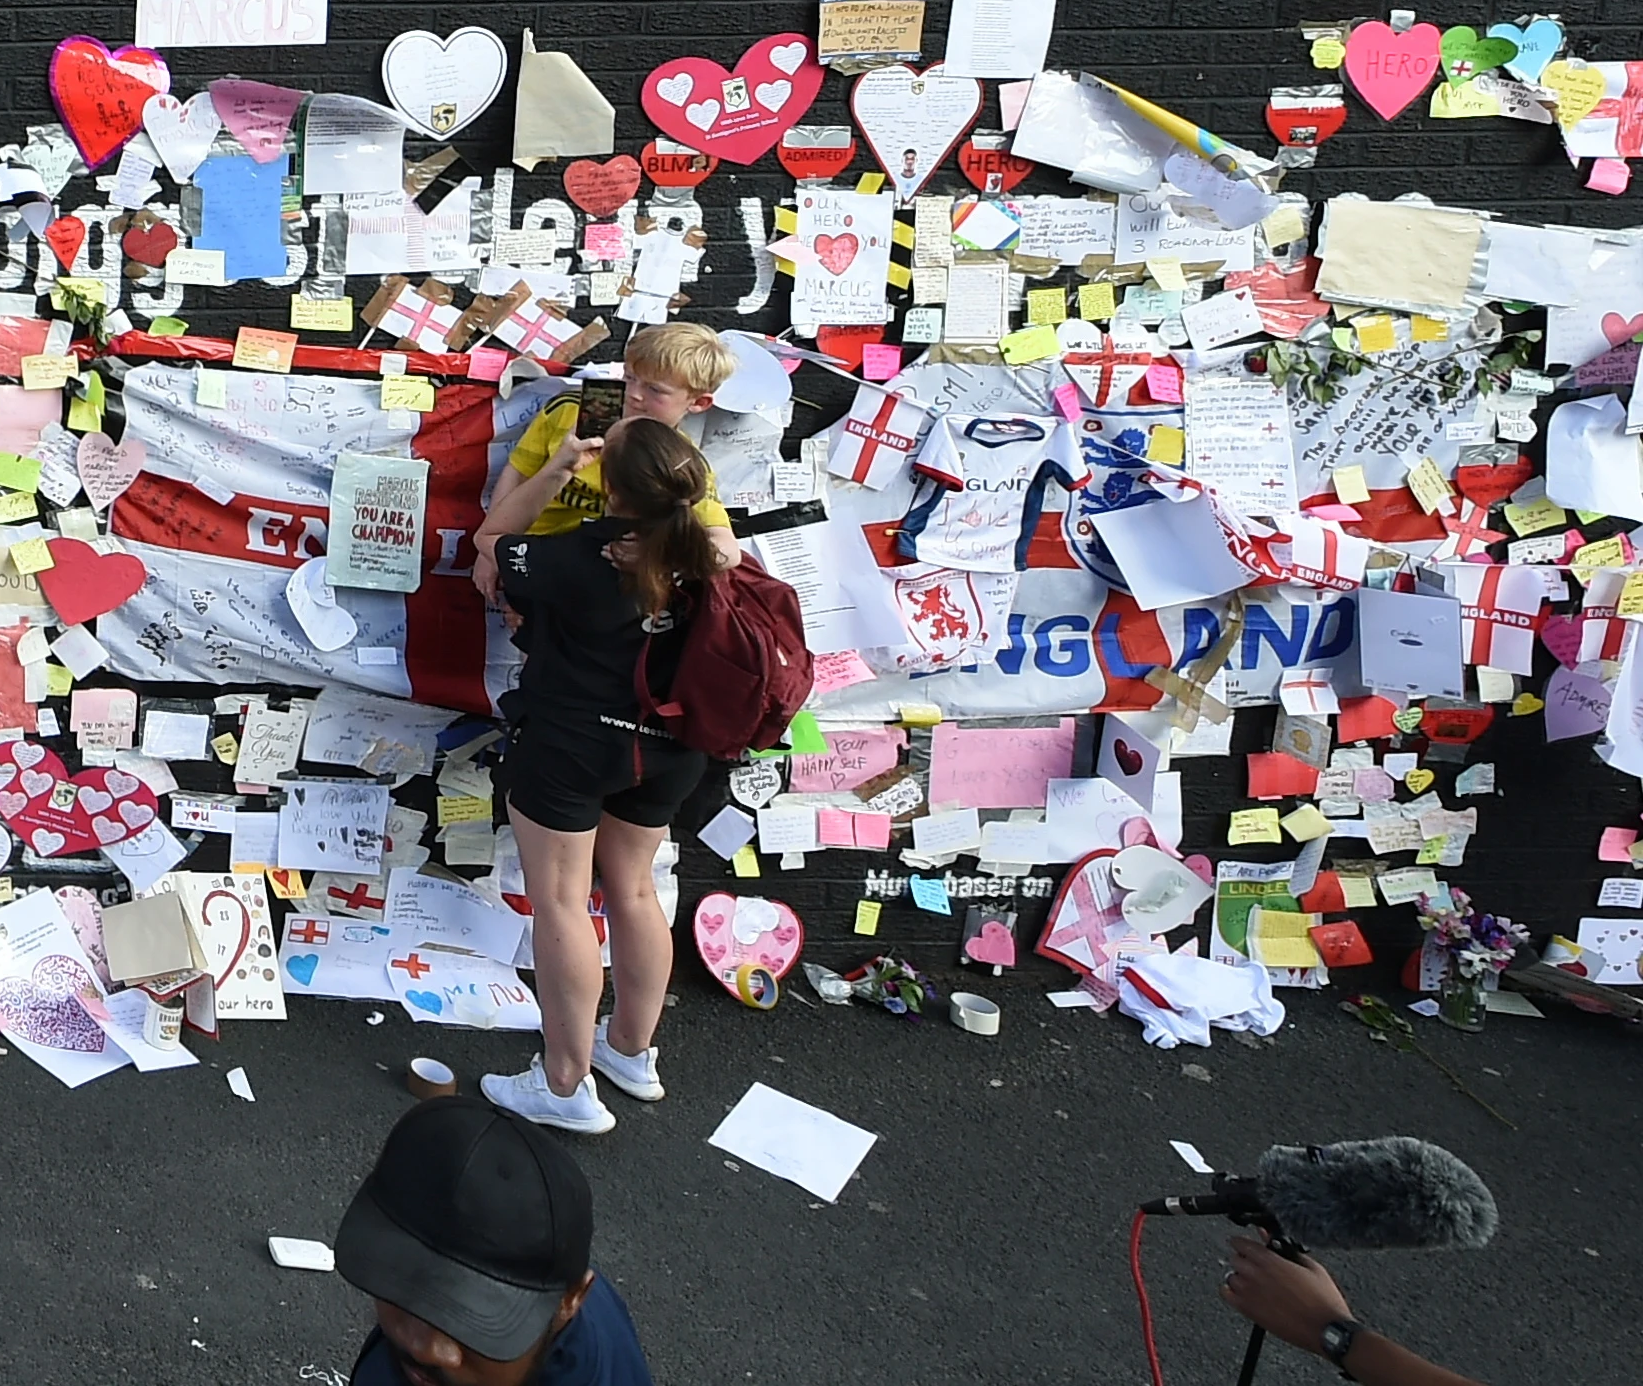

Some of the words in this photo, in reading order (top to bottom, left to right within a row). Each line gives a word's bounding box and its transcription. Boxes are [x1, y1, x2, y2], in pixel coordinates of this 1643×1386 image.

[1366, 50, 1428, 81] HERO
[784, 149, 848, 163] ADMIRED!
[804, 196, 843, 210] OUR
[813, 213, 854, 229] HERO
[1130, 219, 1160, 233] will
[861, 235, 888, 251] YOU
[1131, 239, 1146, 253] 3
[804, 278, 872, 298] MARCUS
[847, 421, 908, 449] ENGLAND
[376, 475, 419, 493] MARCUS
[354, 487, 419, 510] RASHFORD
[353, 505, 378, 523] YOU
[380, 508, 404, 527] ARE
[405, 511, 415, 528] A
[351, 524, 416, 548] CHAMPION
[1296, 566, 1355, 592] ENGLAND
[1461, 606, 1531, 628] NGLAND
[249, 723, 295, 744] Thank
[251, 741, 286, 762] You
[801, 757, 836, 777] HAPPY
[874, 787, 915, 812] LEGEND
[946, 870, 1016, 898] based
[1022, 876, 1055, 898] on
[218, 998, 241, 1011] our
[244, 998, 273, 1011] hero
